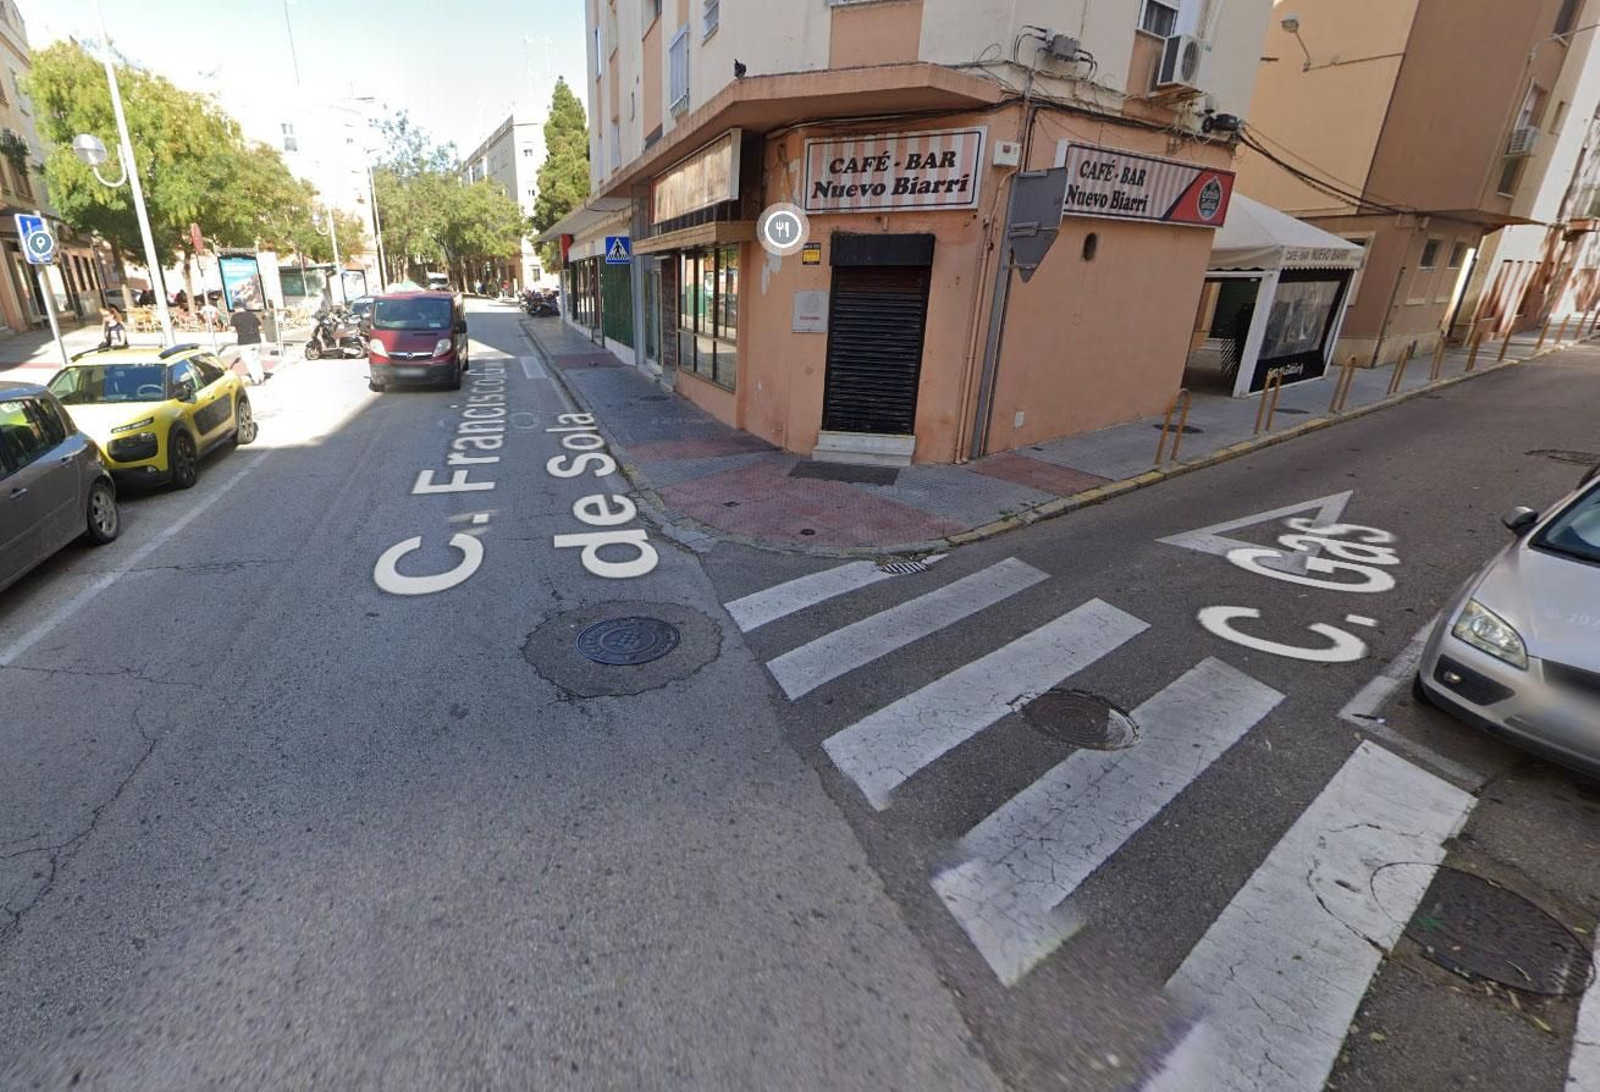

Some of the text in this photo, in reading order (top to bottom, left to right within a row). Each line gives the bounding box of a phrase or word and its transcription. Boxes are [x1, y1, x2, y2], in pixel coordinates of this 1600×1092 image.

[829, 150, 890, 174] CAFÉ
[905, 150, 957, 171] BAR
[1079, 159, 1115, 182] CAFÉ
[1120, 168, 1147, 187] BAR
[811, 181, 886, 199] Nuevo
[1064, 184, 1110, 208] Nuevo
